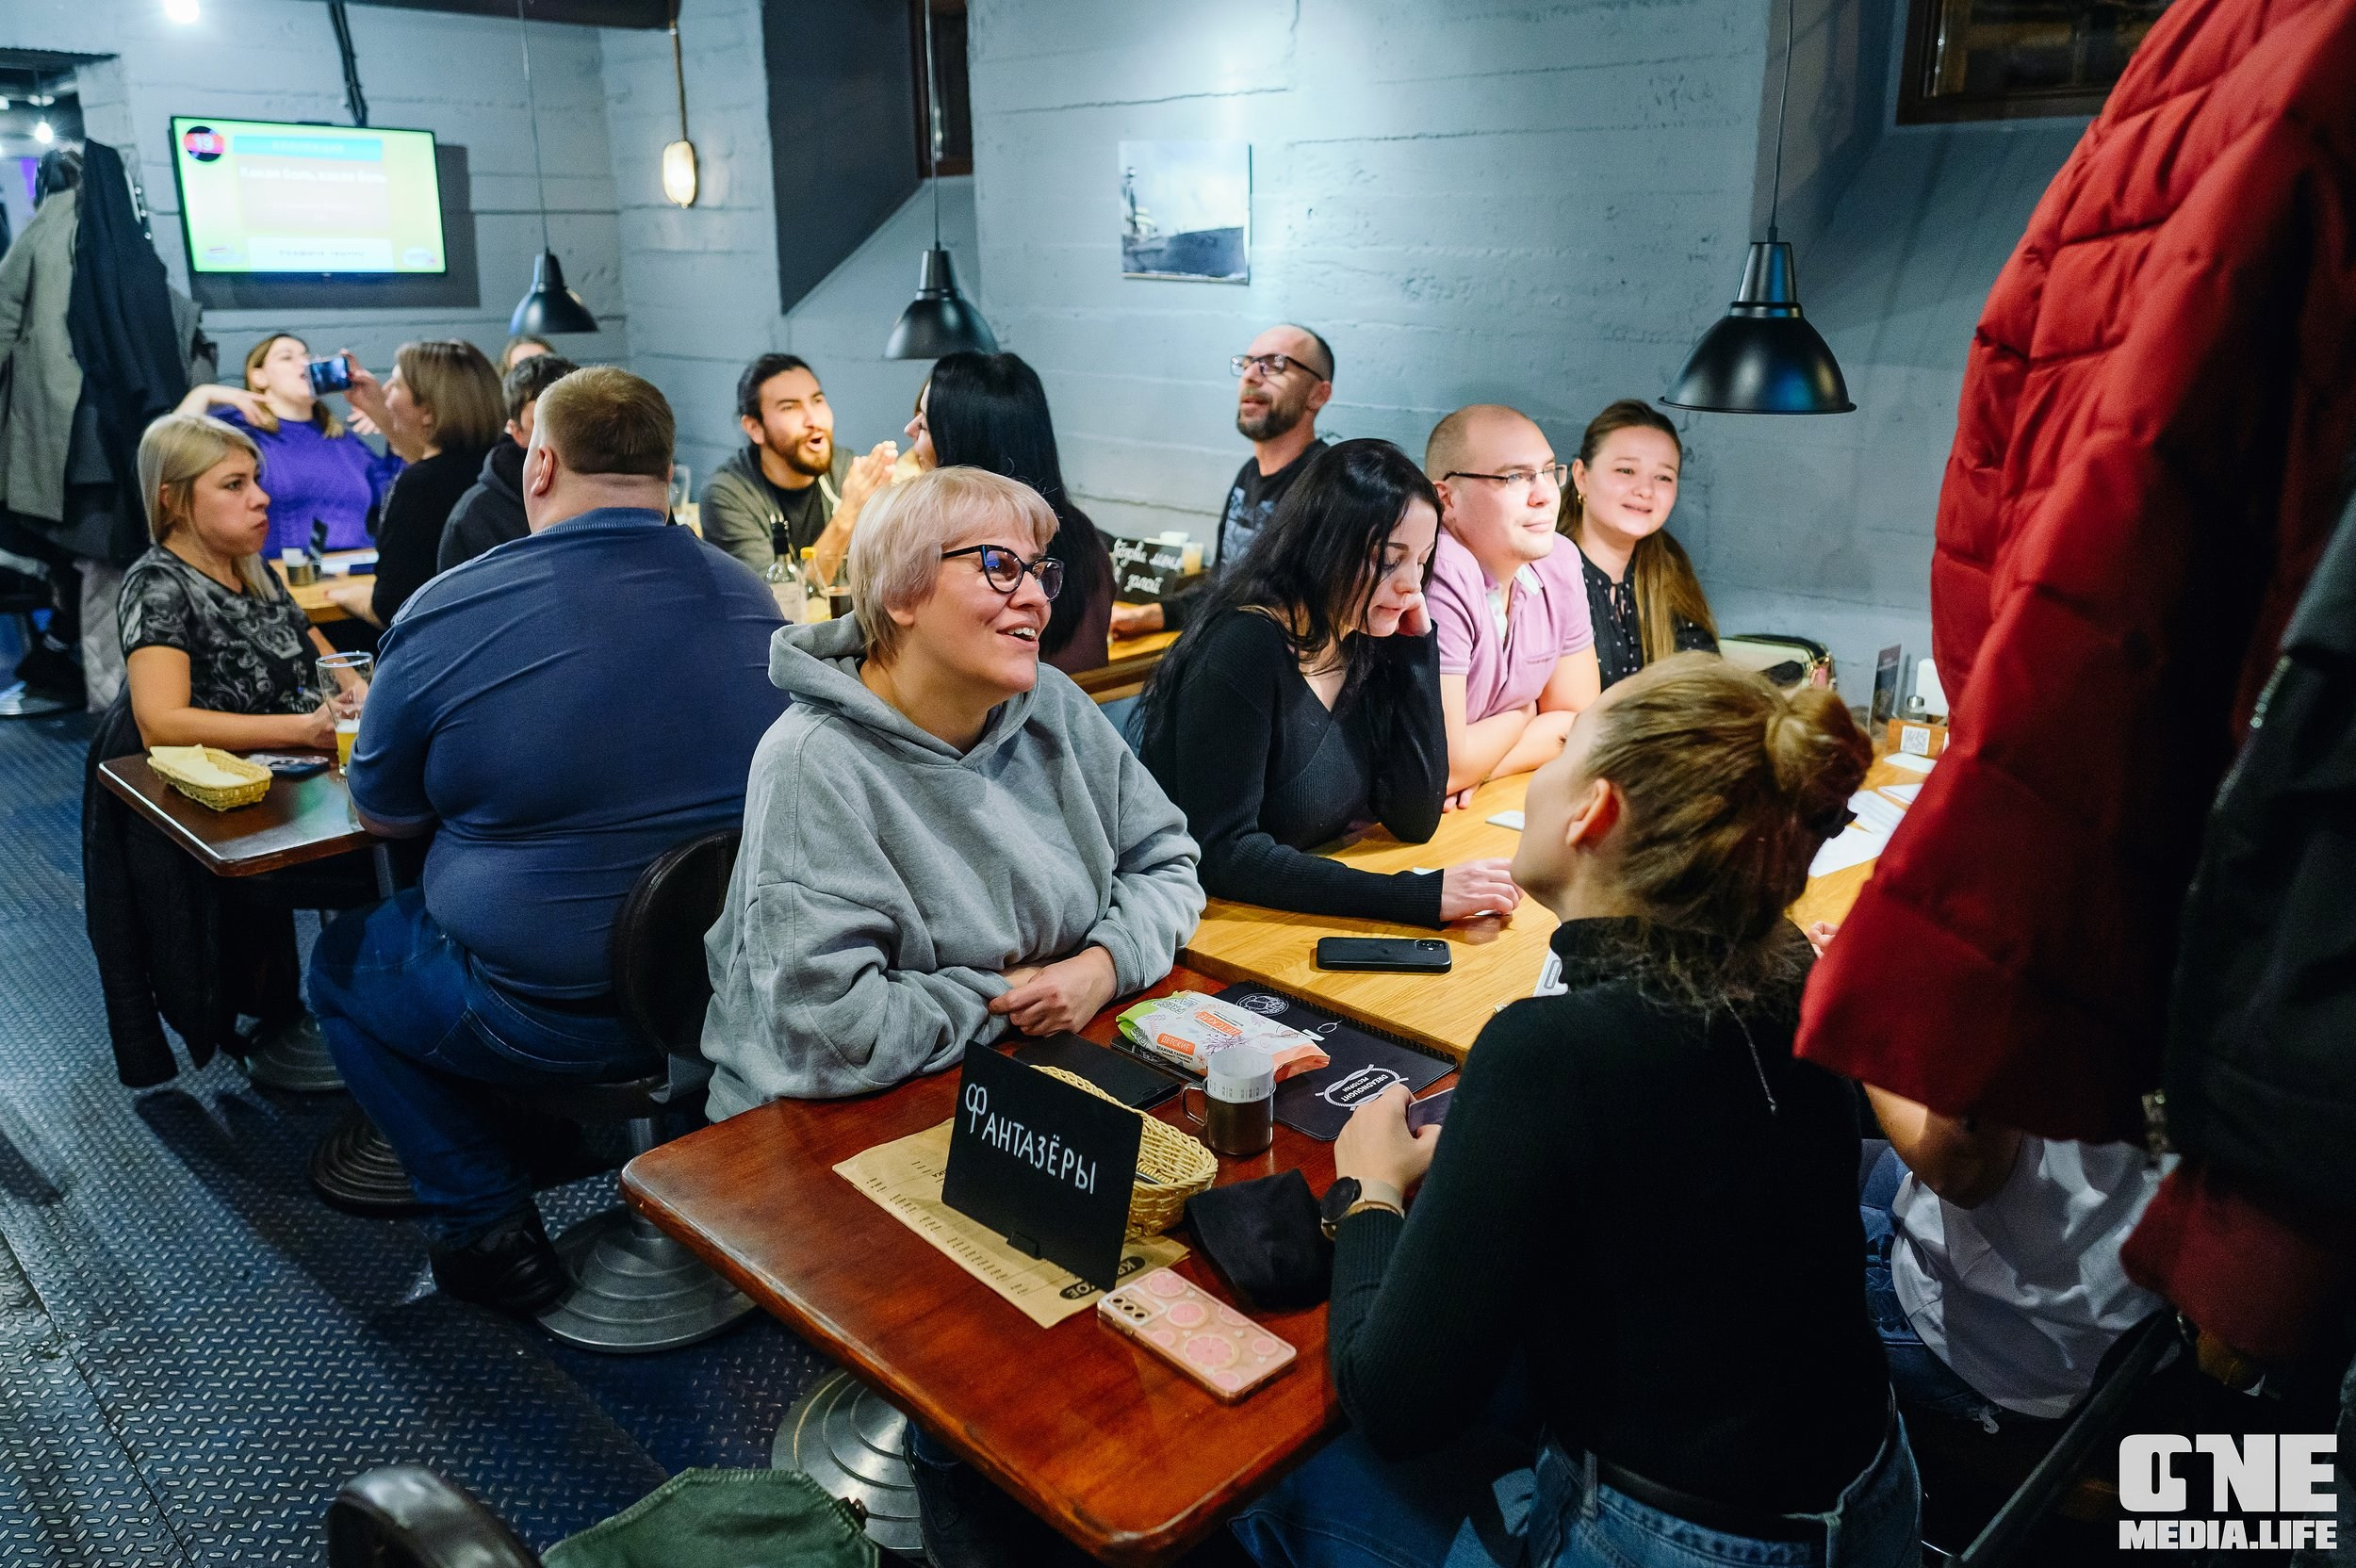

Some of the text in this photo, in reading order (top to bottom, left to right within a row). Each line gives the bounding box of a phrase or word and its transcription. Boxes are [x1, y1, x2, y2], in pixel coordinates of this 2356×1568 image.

[1198, 1013, 1240, 1037] ДЕТСКИЕ
[1160, 1036, 1191, 1053] ДЕТСКИЕ
[1340, 1073, 1388, 1102] DREADNOUGHT
[965, 1083, 1097, 1194] ФАНТАЗЁРЫ
